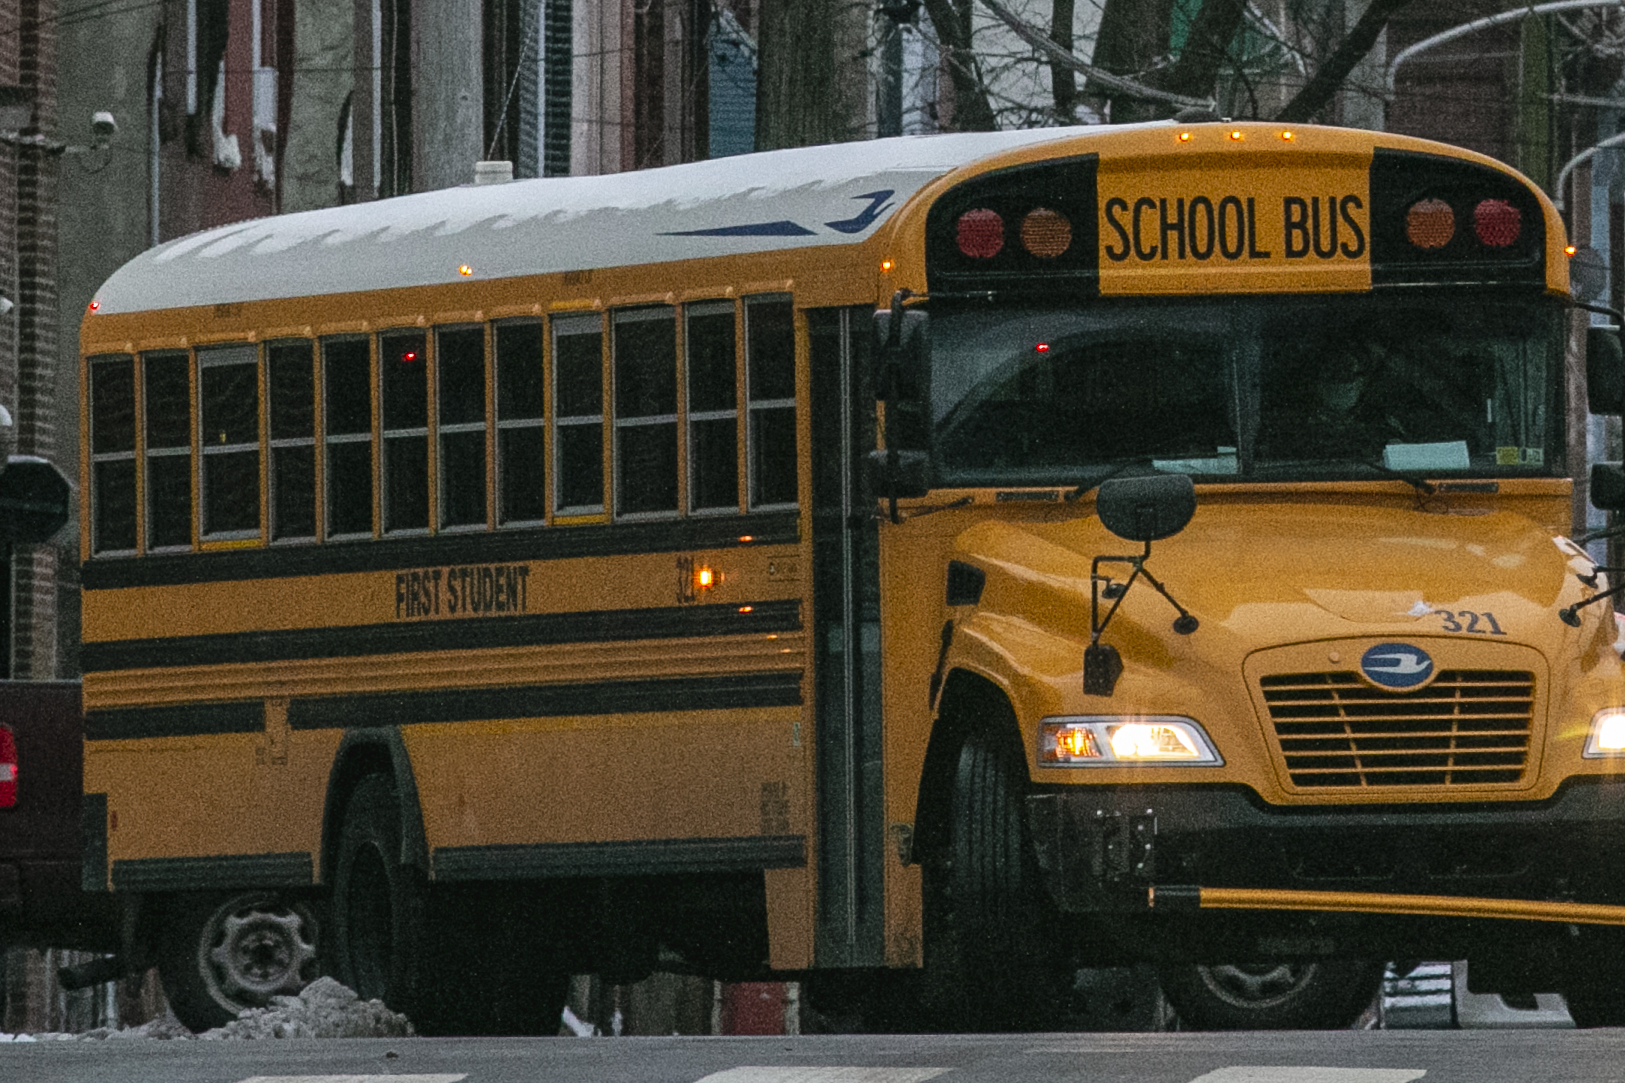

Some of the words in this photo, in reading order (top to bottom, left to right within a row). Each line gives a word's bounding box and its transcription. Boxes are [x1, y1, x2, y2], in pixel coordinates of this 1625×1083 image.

[1105, 195, 1271, 261] SCHOOL
[1283, 193, 1366, 260] BUS
[395, 569, 442, 620] FIRST
[446, 564, 531, 615] STUDENT
[1433, 608, 1507, 636] 321
